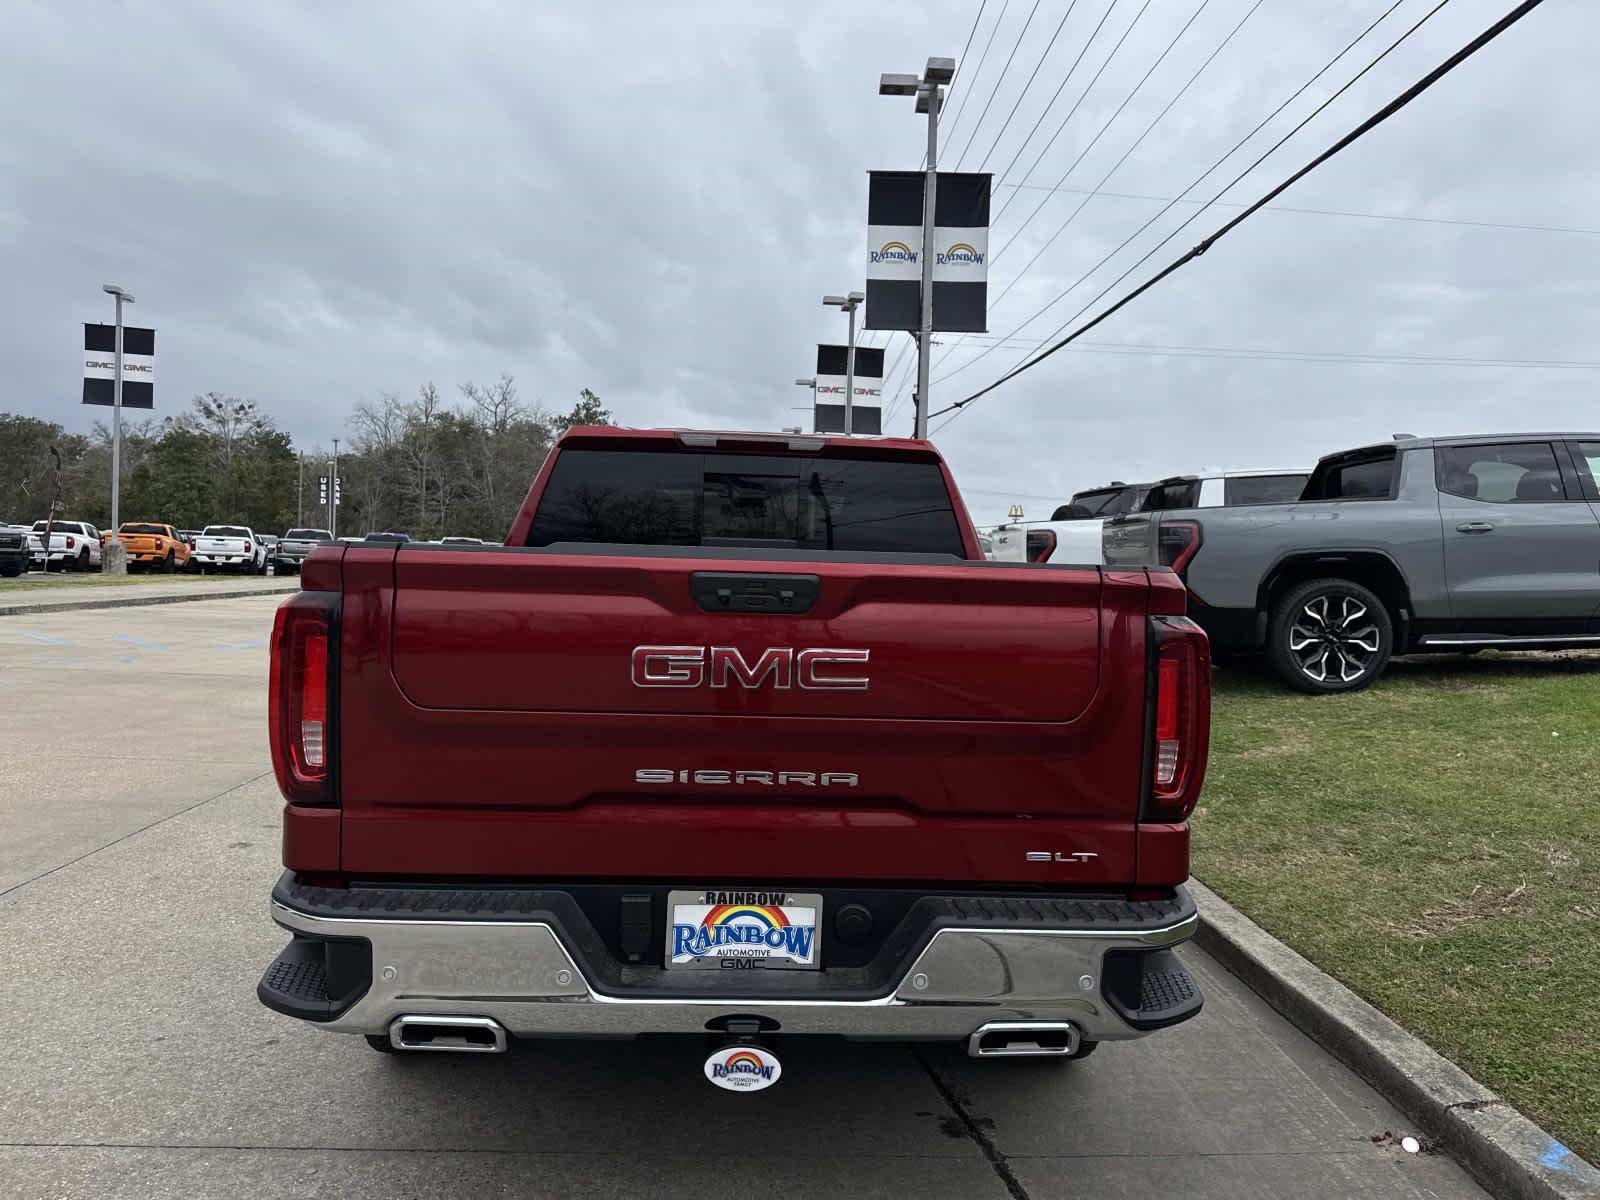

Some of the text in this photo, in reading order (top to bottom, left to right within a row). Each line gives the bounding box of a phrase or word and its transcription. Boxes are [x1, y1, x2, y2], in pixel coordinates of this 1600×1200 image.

[870, 251, 918, 263] RAINBOW
[936, 253, 984, 265] RAINBOW
[86, 361, 115, 369] GMC
[124, 364, 152, 372] GMC
[854, 388, 881, 396] GMC
[631, 645, 870, 691] GMC
[635, 769, 859, 787] SIERRA
[1026, 851, 1099, 863] SLT
[705, 892, 786, 905] RAINBOW
[672, 925, 815, 960] RAINBOW
[717, 949, 771, 957] AUTOMOTIVE
[721, 959, 765, 969] GMC
[712, 1063, 774, 1080] RAINBOW
